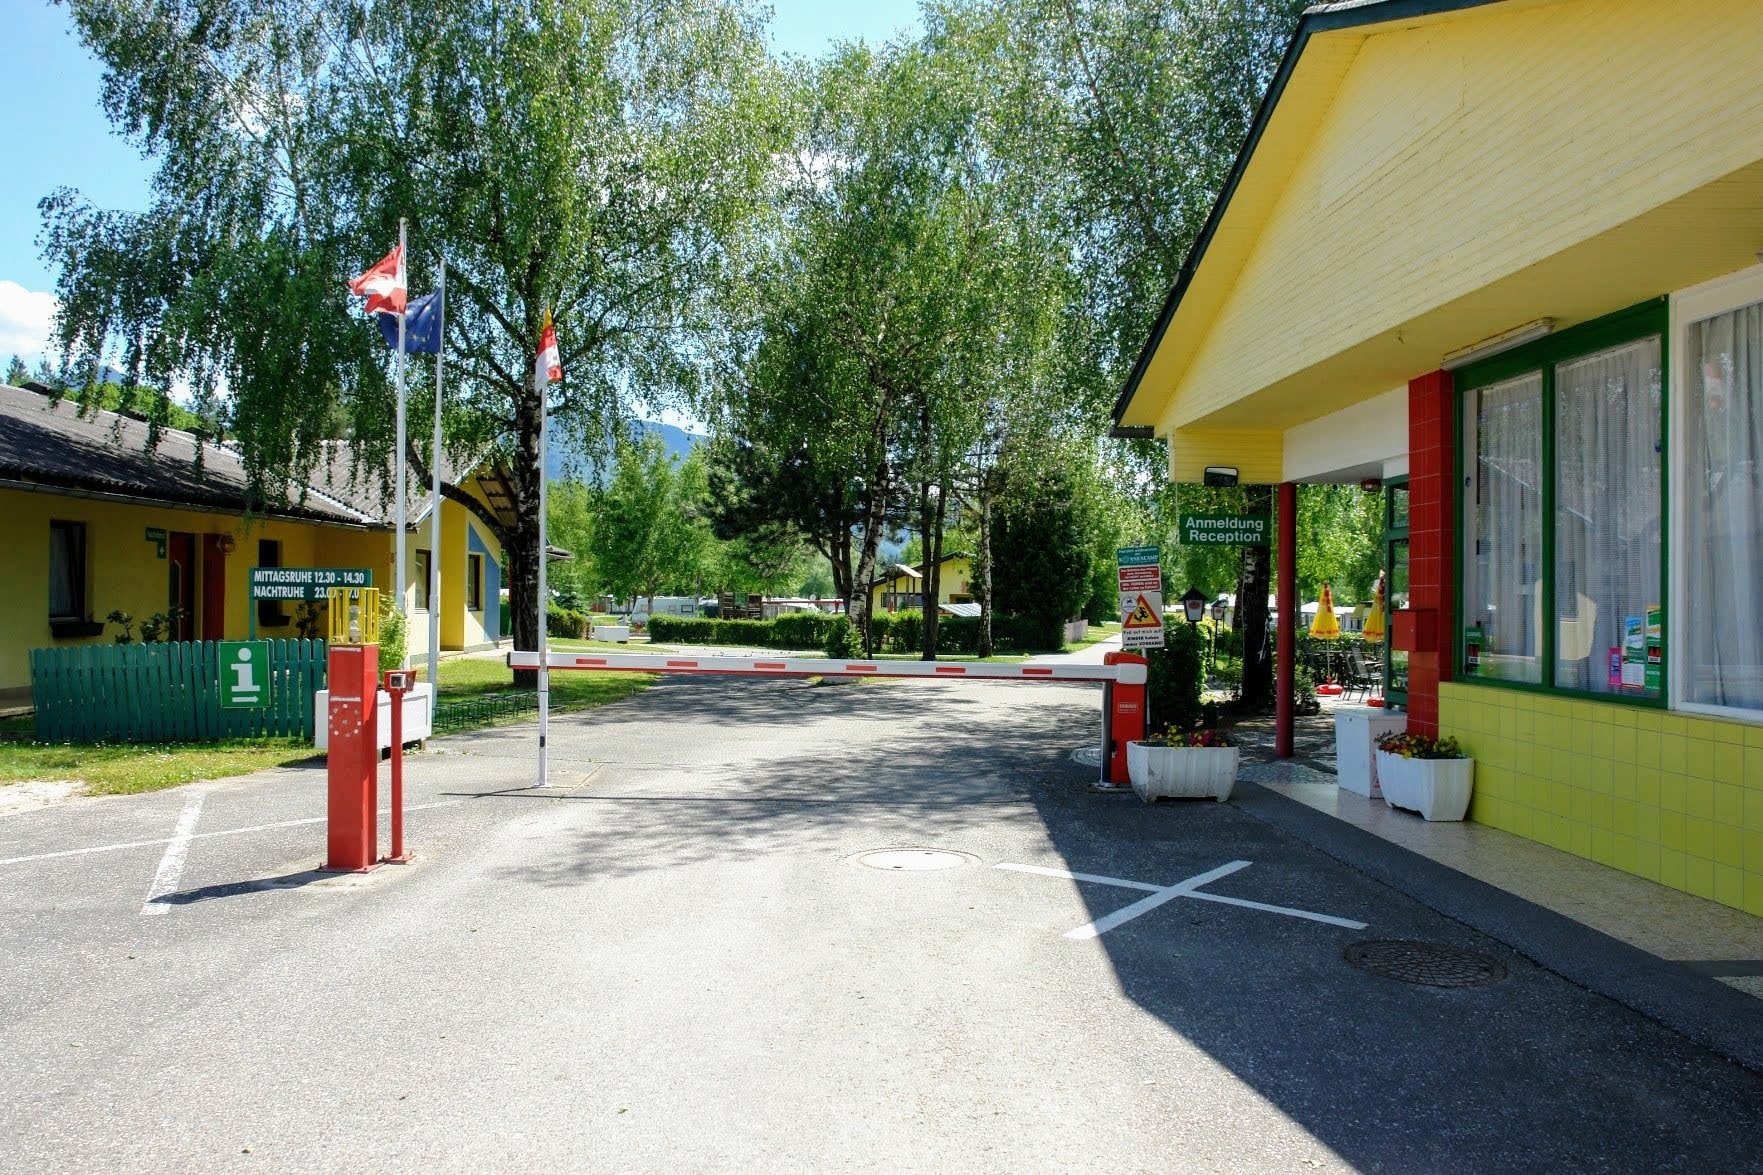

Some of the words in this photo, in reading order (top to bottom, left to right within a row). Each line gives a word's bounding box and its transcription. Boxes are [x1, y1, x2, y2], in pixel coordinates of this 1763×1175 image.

[1185, 516, 1264, 531] Anmeldung
[1189, 530, 1261, 544] Reception
[254, 570, 312, 583] MITTAGSRUHE
[314, 571, 335, 584] 12.30
[343, 572, 364, 584] 14.30
[253, 585, 304, 598] NACHTRUHE
